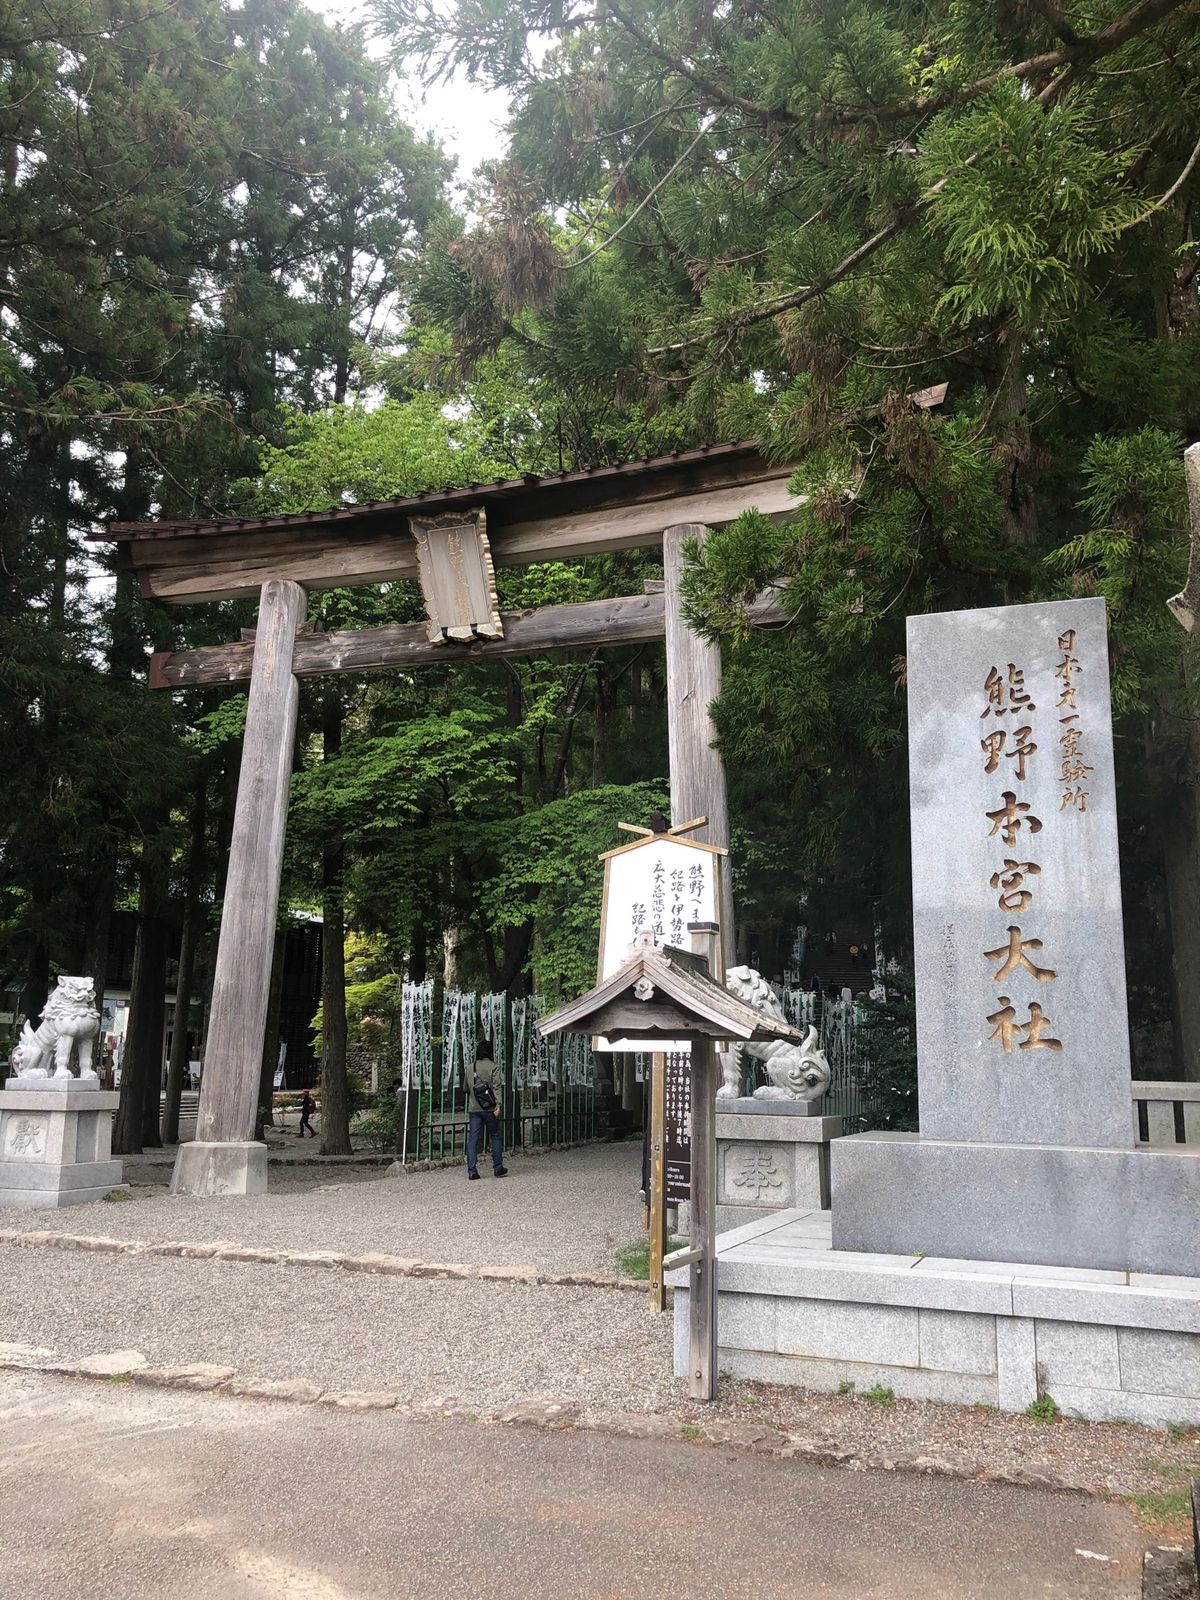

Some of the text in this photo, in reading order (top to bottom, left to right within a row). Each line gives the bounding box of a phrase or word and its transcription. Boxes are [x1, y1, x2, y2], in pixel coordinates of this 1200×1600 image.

[981, 663, 1063, 1054] 熊野本宮大社
[688, 863, 705, 923] 熊野へま
[733, 1149, 782, 1199] 奉
